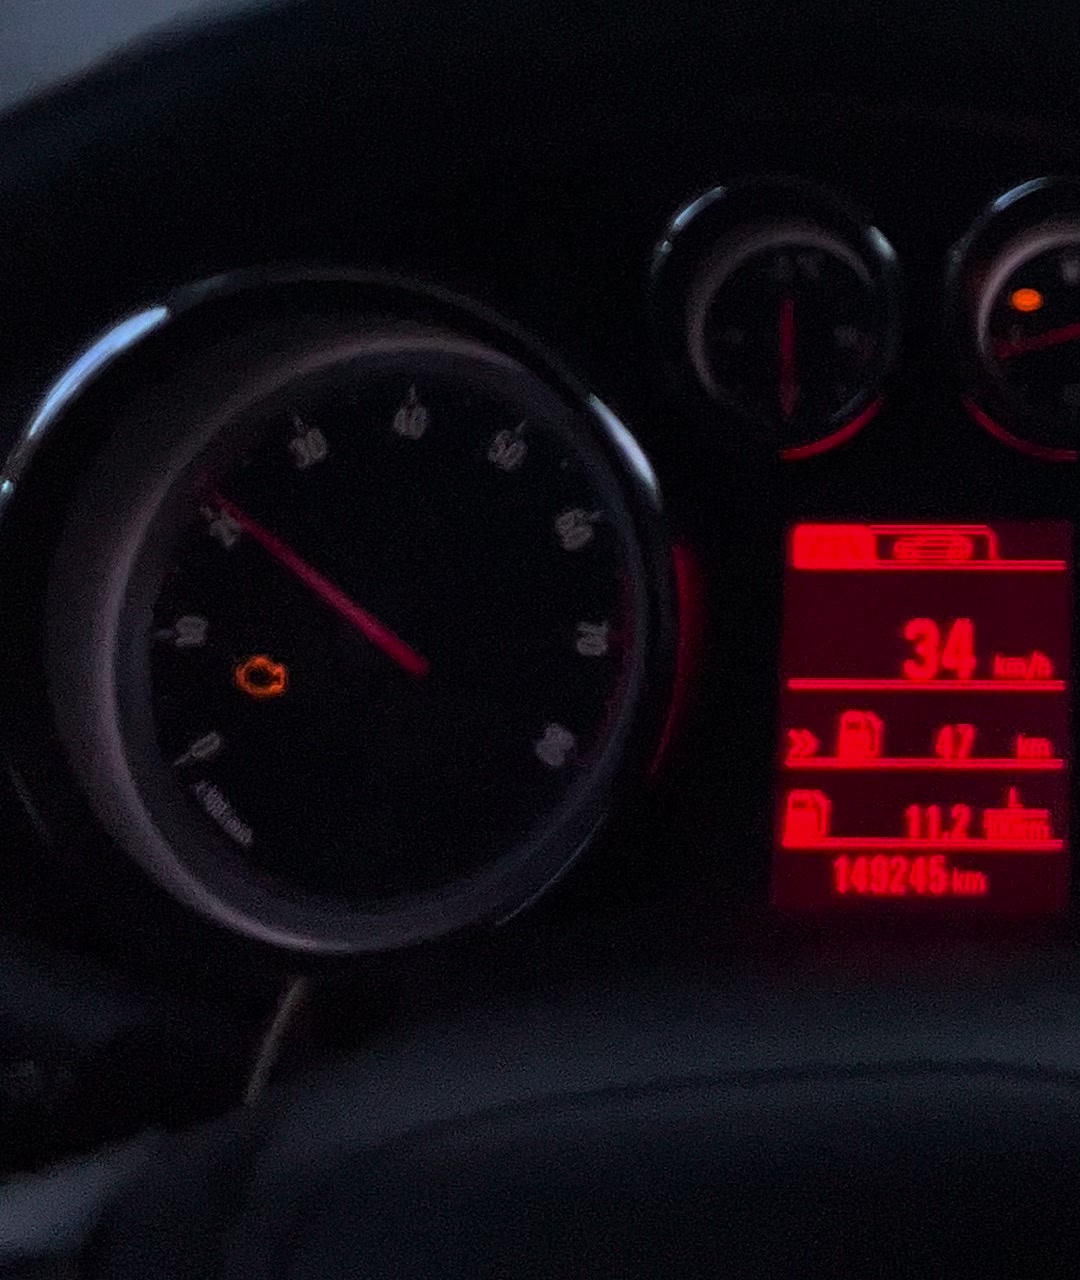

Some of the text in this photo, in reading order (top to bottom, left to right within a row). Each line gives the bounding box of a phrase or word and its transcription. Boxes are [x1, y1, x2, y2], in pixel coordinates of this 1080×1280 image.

[904, 617, 1053, 680] 34 km/h
[934, 724, 1051, 759] 47 km
[905, 804, 971, 840] 11.2
[834, 853, 988, 894] 149245 km
